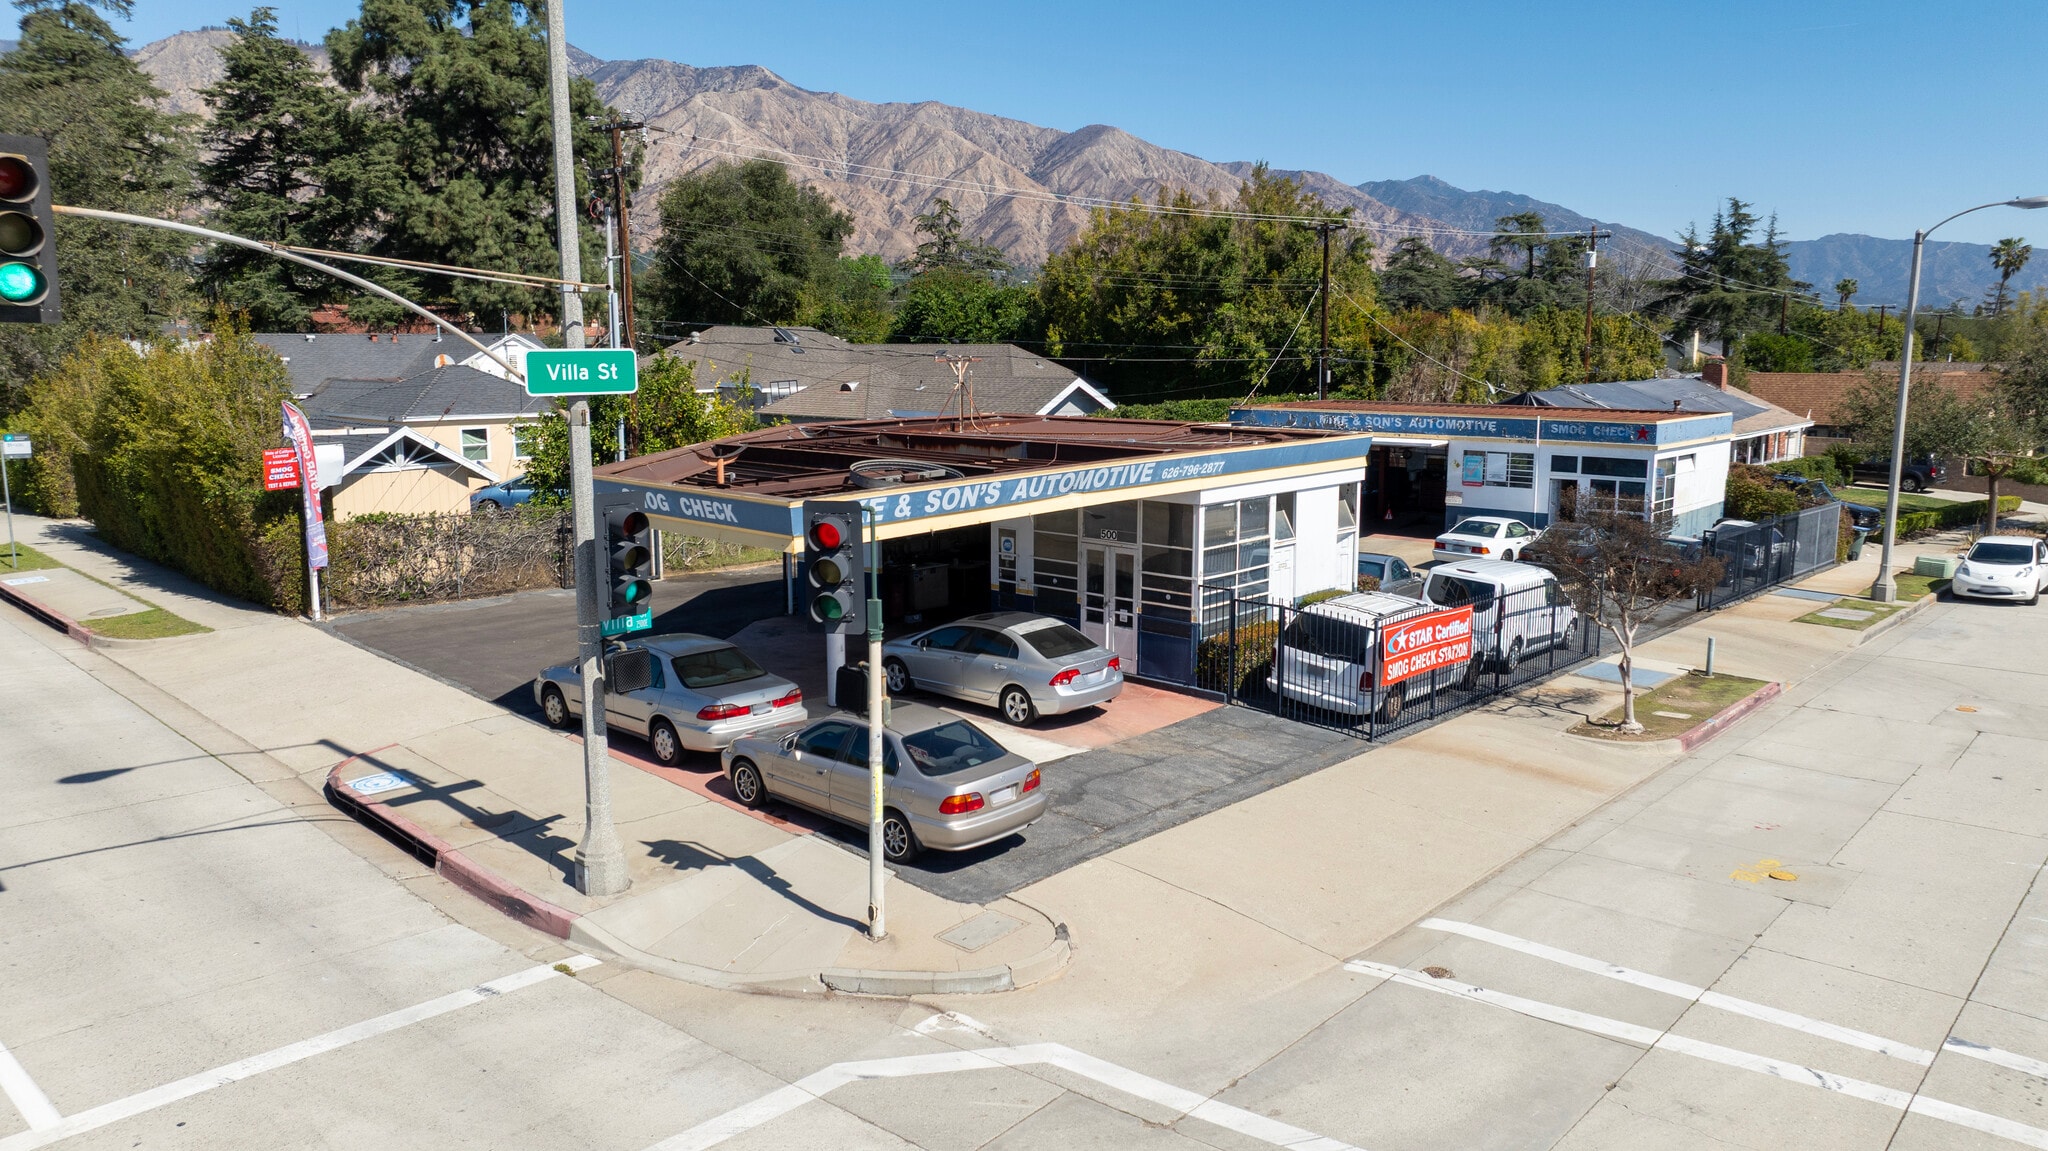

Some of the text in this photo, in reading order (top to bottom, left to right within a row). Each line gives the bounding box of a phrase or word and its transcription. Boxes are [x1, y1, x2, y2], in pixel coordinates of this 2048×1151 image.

[546, 363, 618, 381] Villa St
[1353, 416, 1361, 426] &
[1365, 416, 1402, 427] SON'S
[1409, 417, 1497, 431] AUTOMOTIVE
[1550, 424, 1586, 435] SMOG
[269, 472, 296, 480] CHECK
[270, 465, 293, 474] SMOG
[894, 494, 911, 518] &
[924, 481, 1002, 513] SON'S
[1010, 462, 1156, 500] AUTOMOTIVE
[1161, 461, 1225, 480] 626-796-2877
[679, 497, 738, 523] CHECK
[1101, 529, 1117, 540] 500
[1408, 617, 1470, 648] STAR Certified
[1387, 641, 1469, 681] SMOG CHECK STATION
